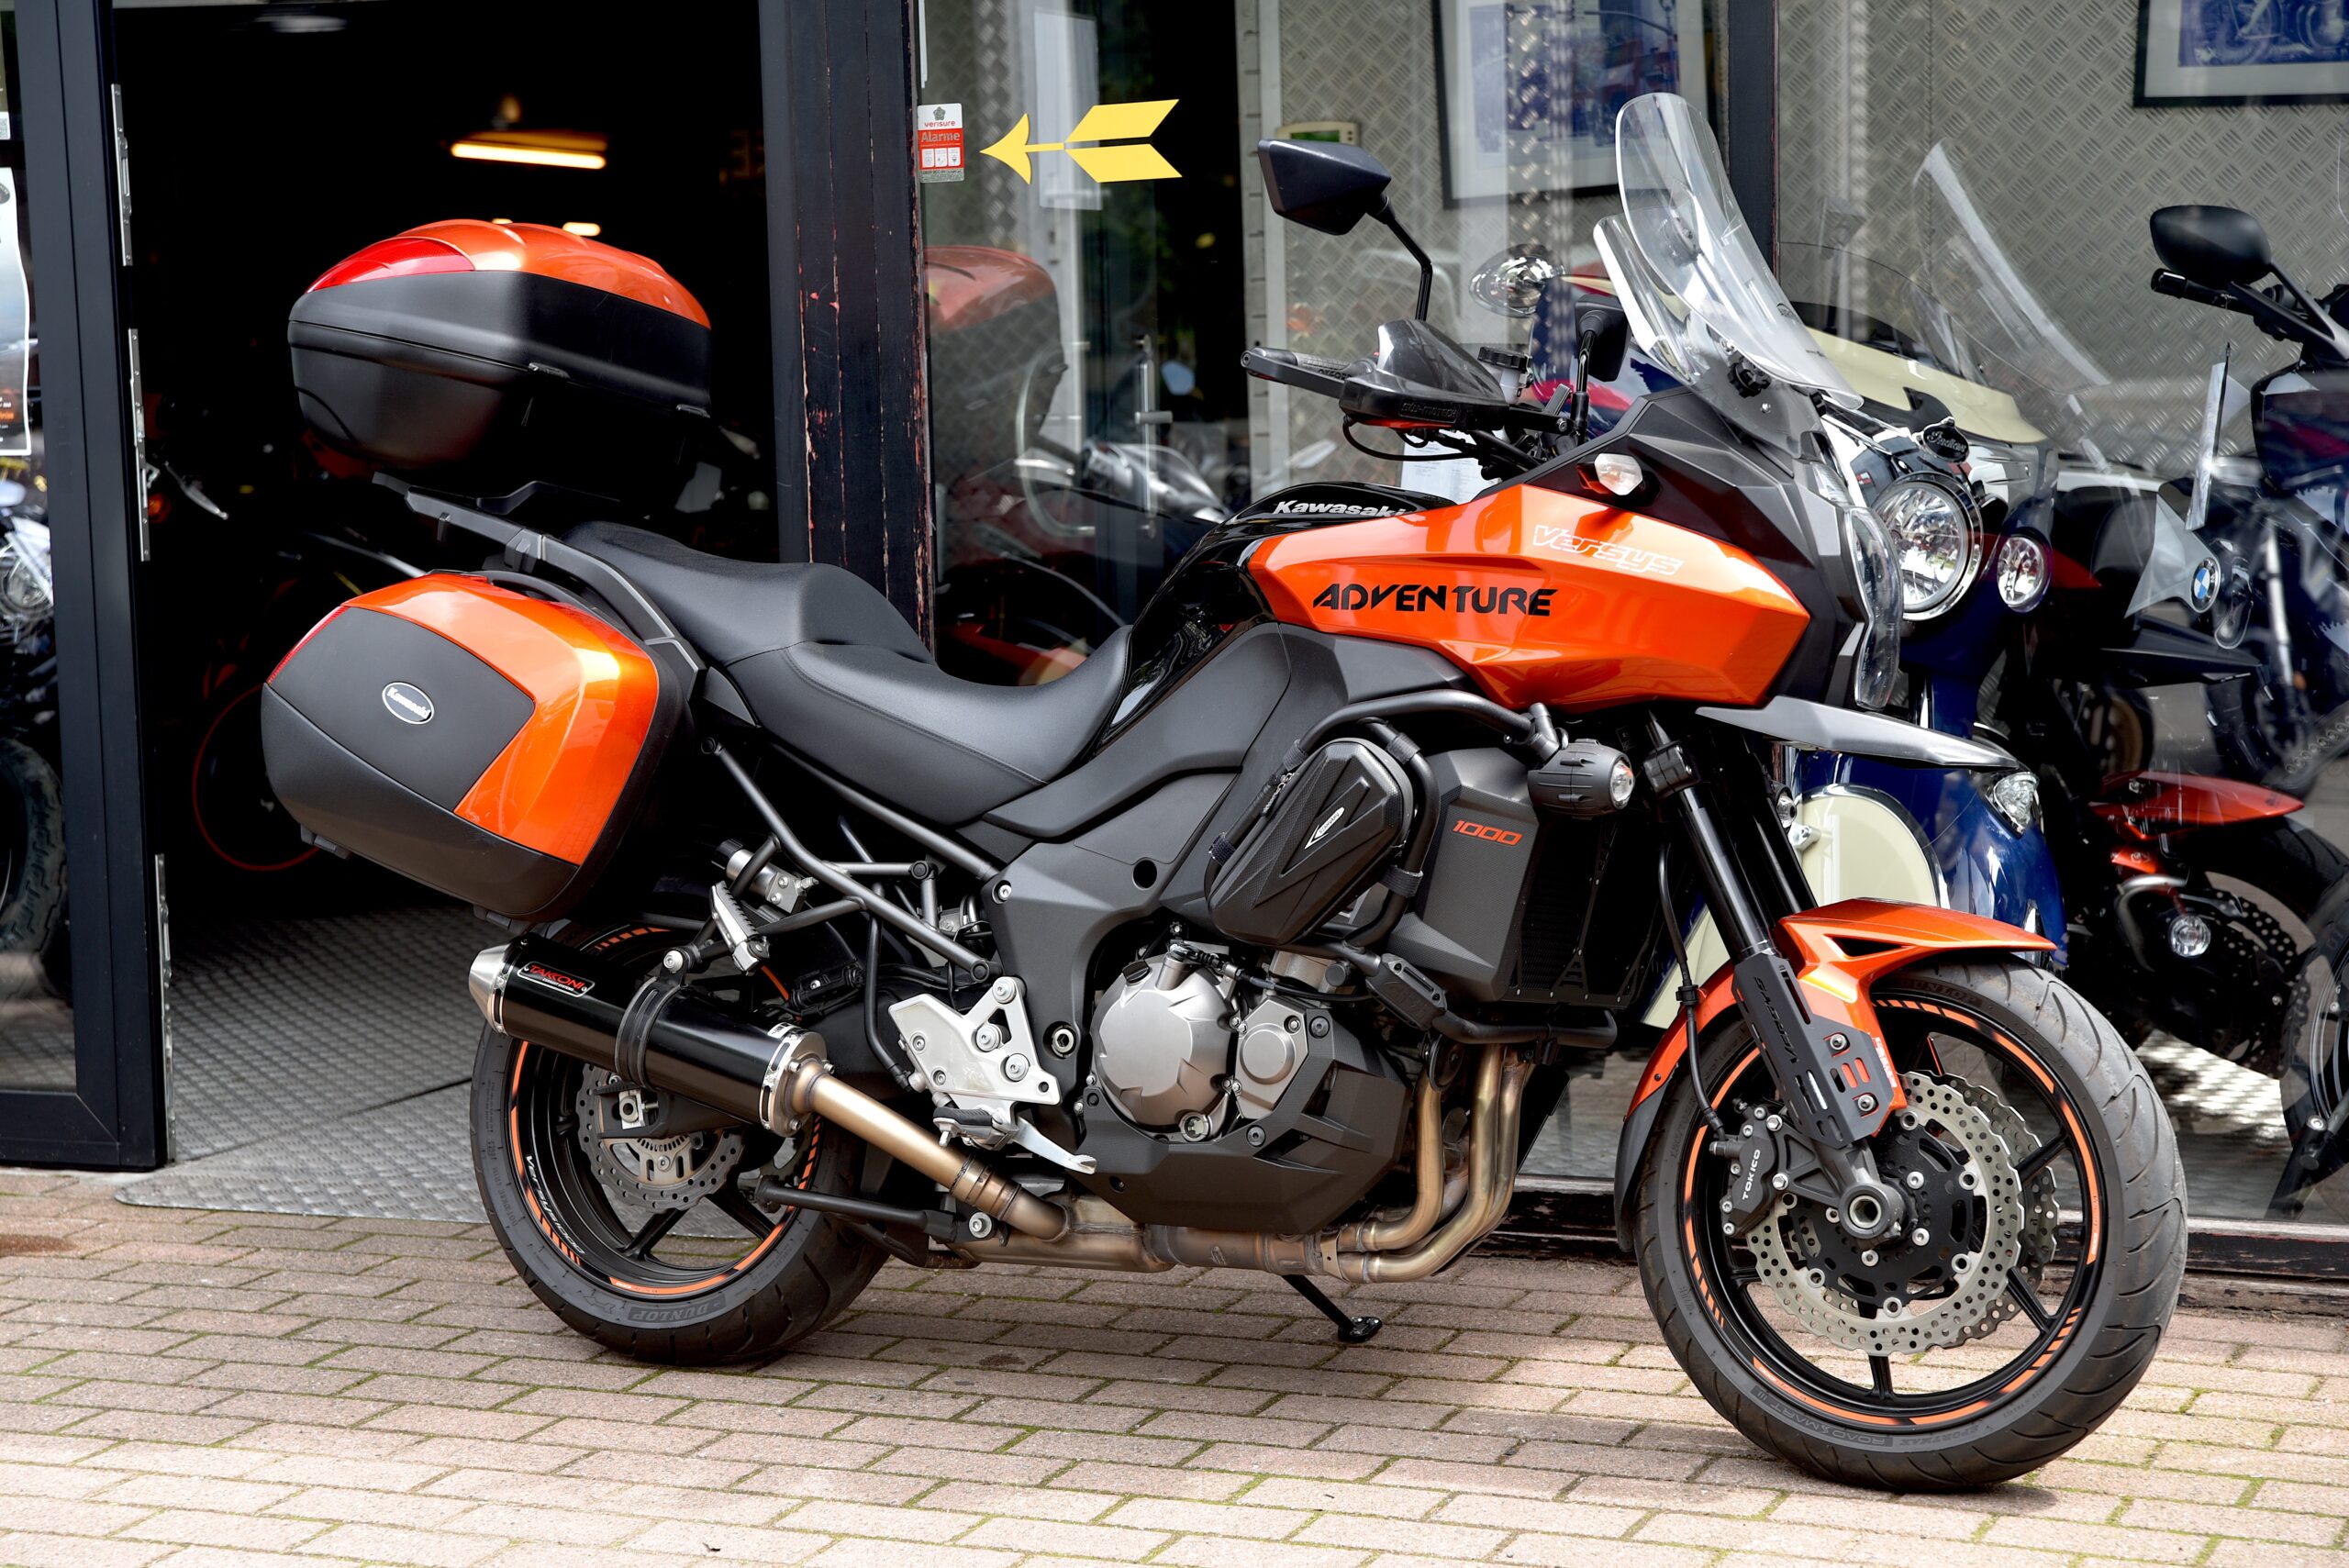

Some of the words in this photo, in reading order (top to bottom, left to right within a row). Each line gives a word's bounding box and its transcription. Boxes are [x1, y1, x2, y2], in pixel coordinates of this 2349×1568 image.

[921, 131, 961, 142] Alarme
[1533, 524, 1684, 576] Versys
[1313, 583, 1559, 617] ADVENTURE
[1453, 819, 1523, 846] 1000
[1742, 1149, 1761, 1200] TOKICO
[634, 1306, 709, 1321] DUNLOP
